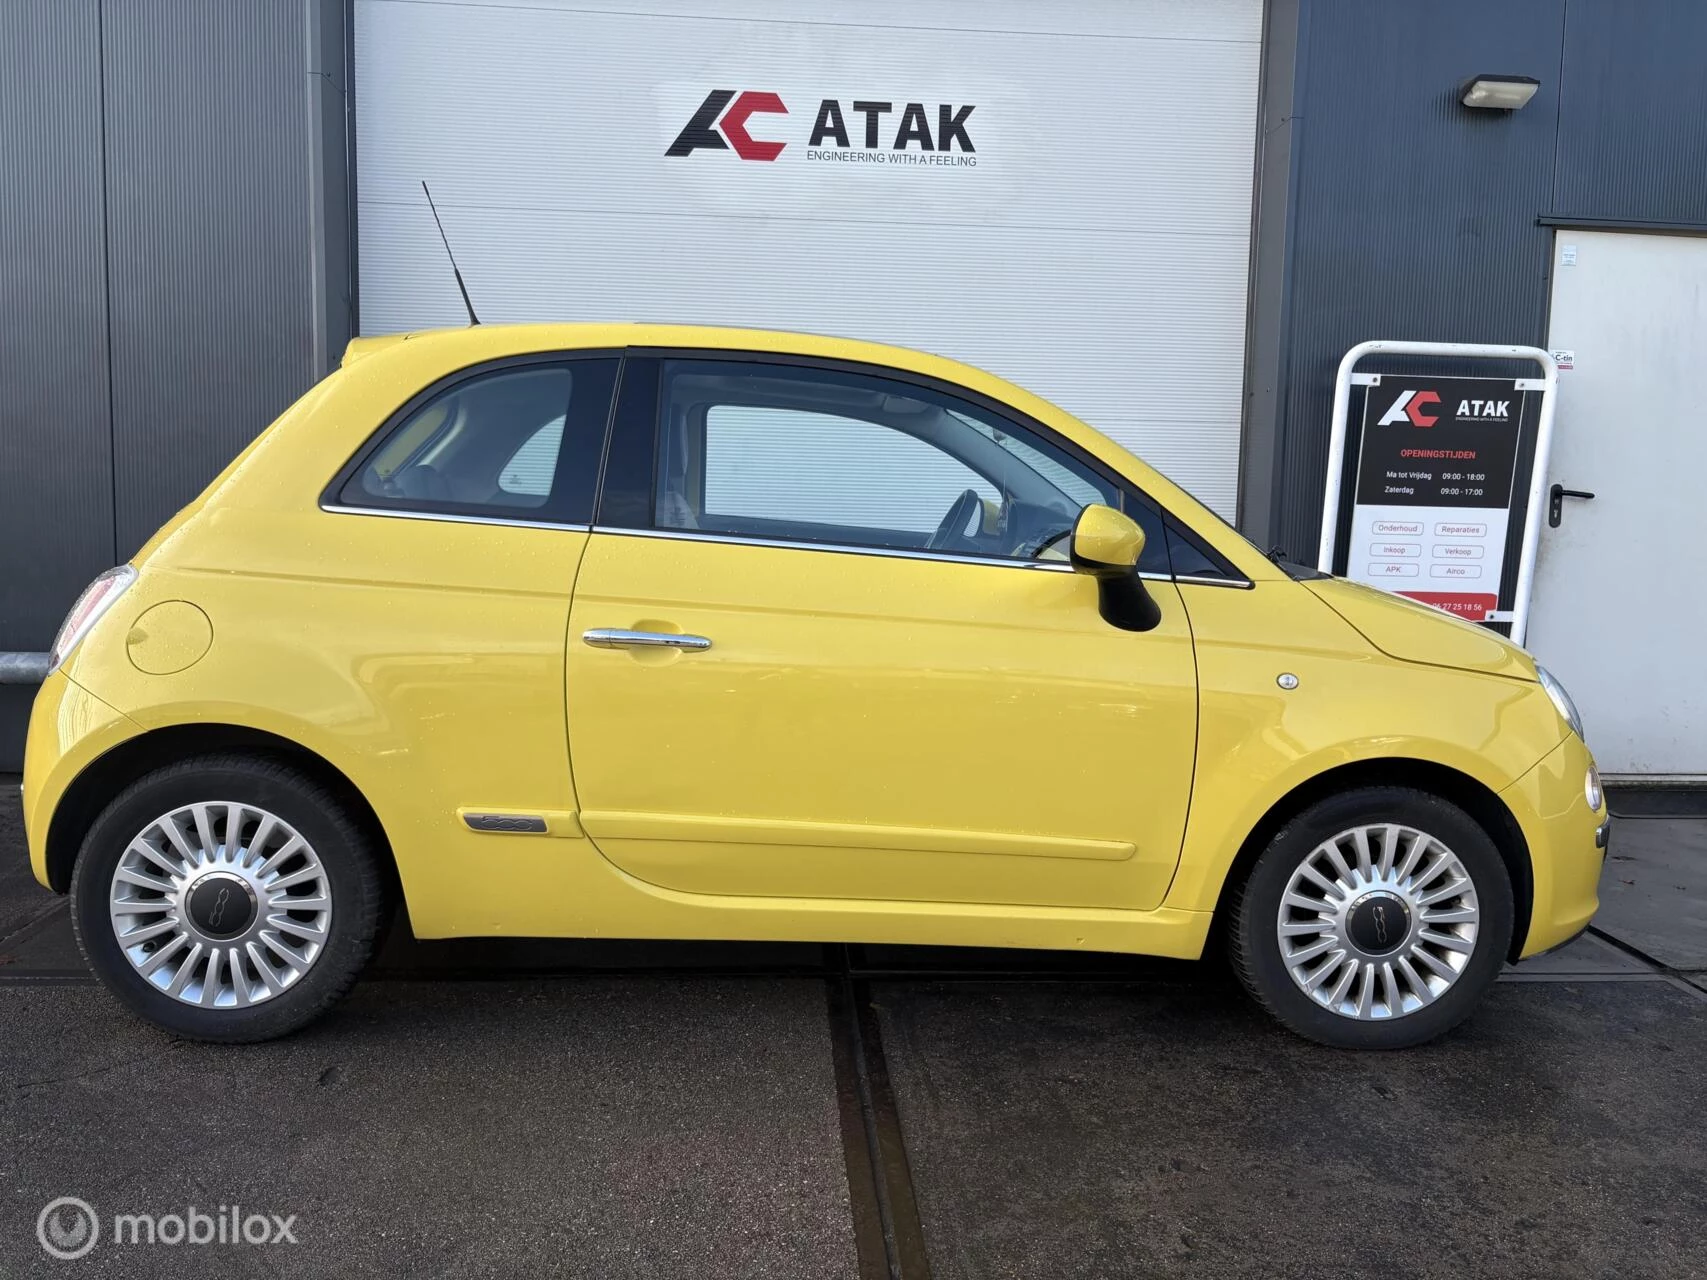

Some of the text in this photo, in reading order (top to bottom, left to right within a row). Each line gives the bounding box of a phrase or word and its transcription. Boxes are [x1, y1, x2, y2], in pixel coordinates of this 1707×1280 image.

[808, 99, 977, 153] ATAK
[807, 150, 977, 167] ENGINEERING WITH A FEELING
[1456, 400, 1510, 417] ATAK
[1400, 449, 1476, 460] OPENINGSTIJDEN
[1386, 471, 1397, 479] Ma
[1398, 471, 1408, 479] tot
[1408, 471, 1432, 481] Vrijdag
[1442, 472, 1461, 480] 09:00
[1466, 473, 1485, 481] 18:00
[1384, 485, 1414, 495] Zaterdag
[1440, 487, 1460, 495] 09:00
[1465, 488, 1483, 496] 17:00
[1378, 524, 1480, 535] Onderhoud Reparaties
[1383, 546, 1472, 556] Inkoop Verkoop
[1385, 565, 1465, 575] APK Airco
[1463, 603, 1472, 611] 18
[1473, 603, 1482, 611] 56
[481, 815, 533, 831] 500
